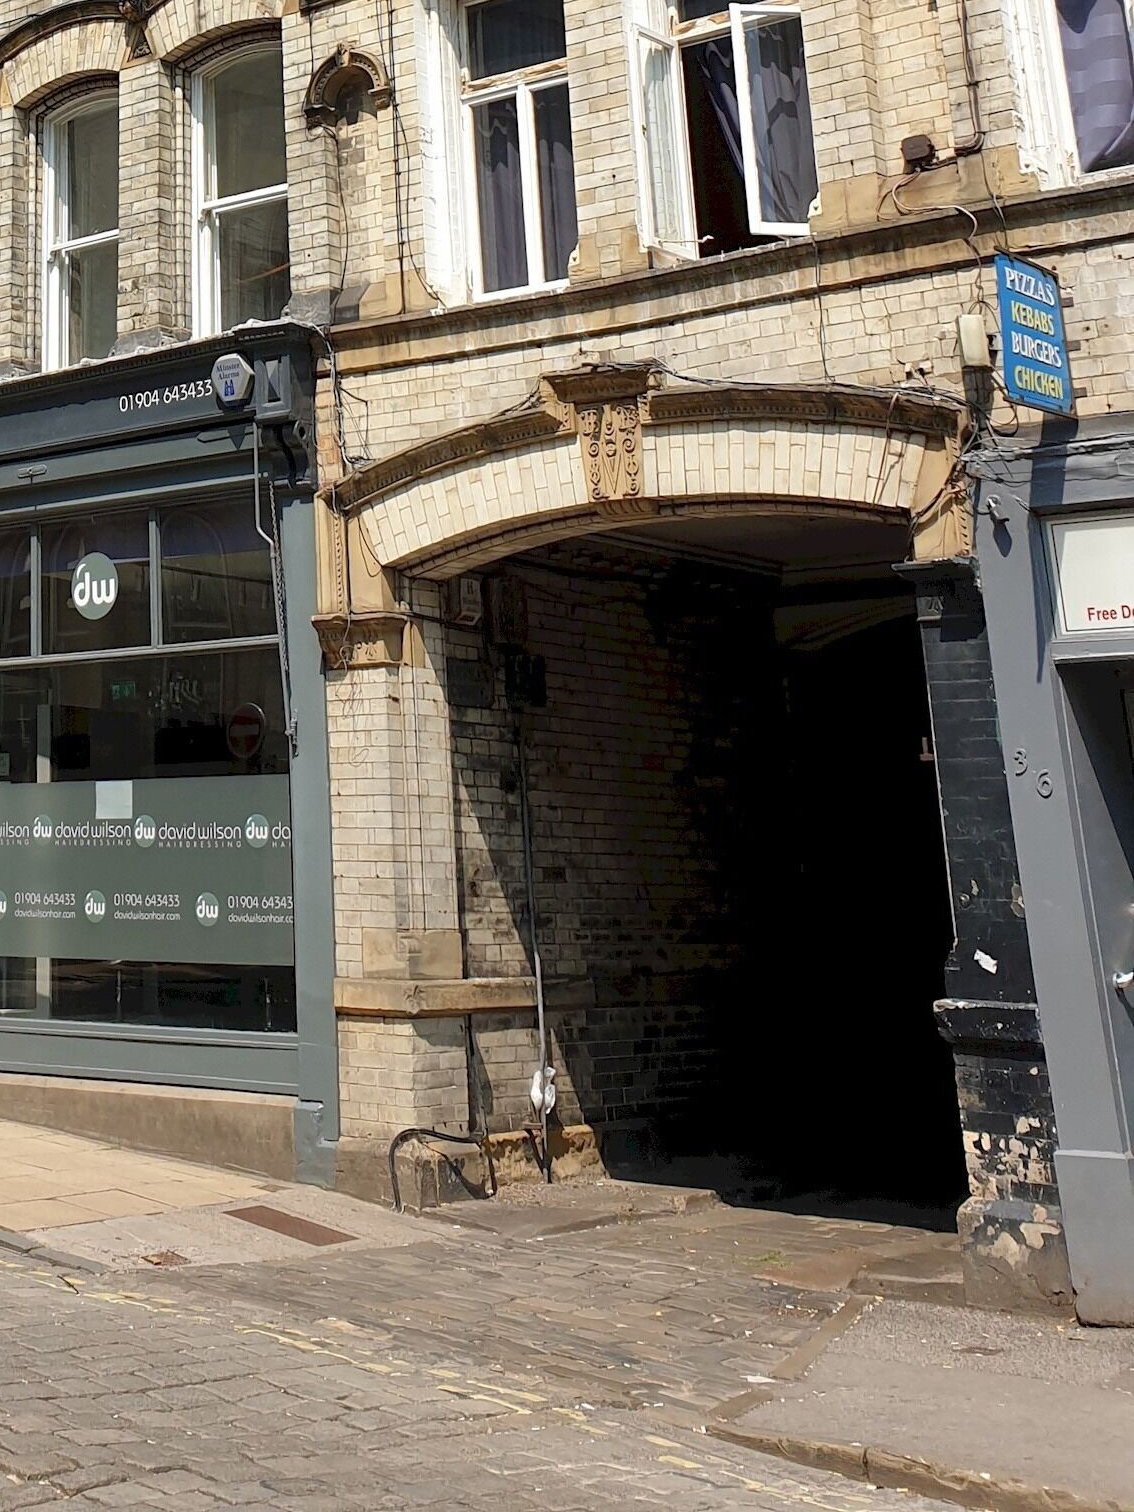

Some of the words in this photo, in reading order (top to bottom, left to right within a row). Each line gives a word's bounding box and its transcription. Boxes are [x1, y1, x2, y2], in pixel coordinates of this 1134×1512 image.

[1004, 266, 1055, 307] PIZZAS
[1011, 300, 1055, 336] KEBABS
[1011, 331, 1062, 369] BURGERS
[1014, 365, 1063, 400] CHICKEN
[119, 389, 159, 412] 01904
[163, 379, 213, 404] 643433
[1087, 606, 1117, 622] Free
[1013, 748, 1053, 799] 36
[158, 840, 242, 848] HAIRDRESSING
[14, 891, 41, 905] 01904
[43, 893, 76, 906] 643433
[113, 893, 142, 907] 01904
[144, 894, 181, 908] 643433
[227, 895, 259, 909] 01904
[14, 908, 76, 919] davidwilsonhair.com
[113, 910, 181, 921] davidwilsonhair.com
